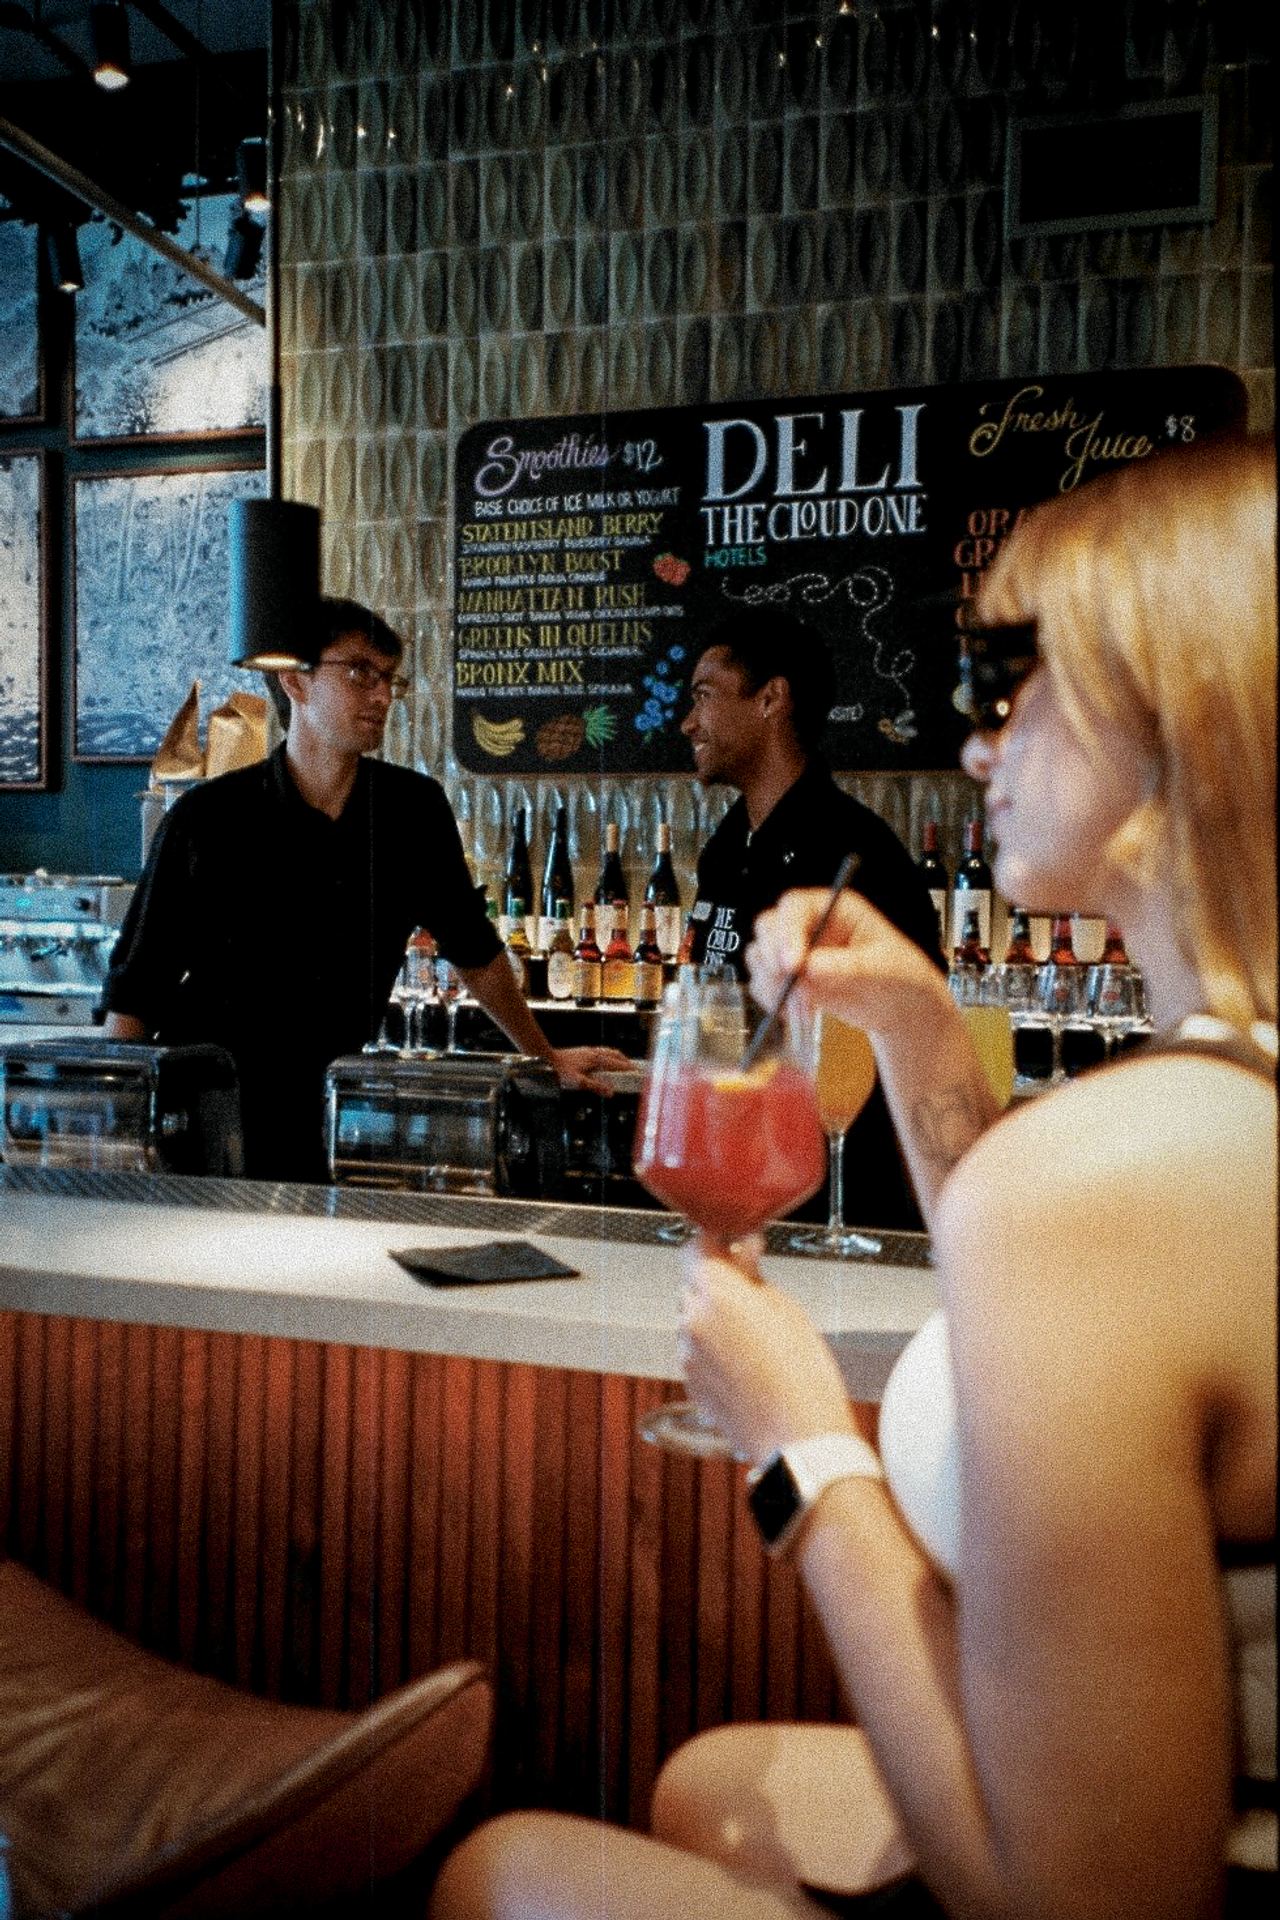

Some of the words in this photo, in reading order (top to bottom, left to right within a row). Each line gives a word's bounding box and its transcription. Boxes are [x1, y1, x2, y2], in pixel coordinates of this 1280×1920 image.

[970, 385, 1083, 457] Fresh
[474, 434, 612, 497] Smoothies
[623, 439, 664, 472] $12
[702, 402, 927, 501] DELI
[1059, 410, 1153, 493] Juice
[1165, 414, 1196, 442] $8
[475, 500, 503, 518] BASE
[507, 498, 543, 514] CHOICE
[546, 497, 559, 512] OF
[564, 493, 584, 512] ICE
[586, 492, 616, 510] MILK
[618, 491, 634, 508] OR
[635, 486, 682, 506] YOGURT
[462, 520, 527, 543] STATEN
[530, 515, 593, 541] ISLAND
[602, 511, 664, 536] BERRY
[700, 503, 766, 546] THE
[768, 499, 858, 541] CLOUD
[863, 494, 928, 536] ONE
[458, 551, 556, 577] BROOKLYN
[564, 549, 624, 572] BOOST
[704, 546, 767, 568] HOTELS
[458, 586, 584, 612] MANHATTAN
[596, 581, 646, 608] RUSH
[458, 624, 532, 649] GREENS
[540, 624, 560, 647] IN
[567, 620, 652, 647] QUEENS
[456, 660, 530, 686] BRONX
[537, 660, 584, 684] MIX
